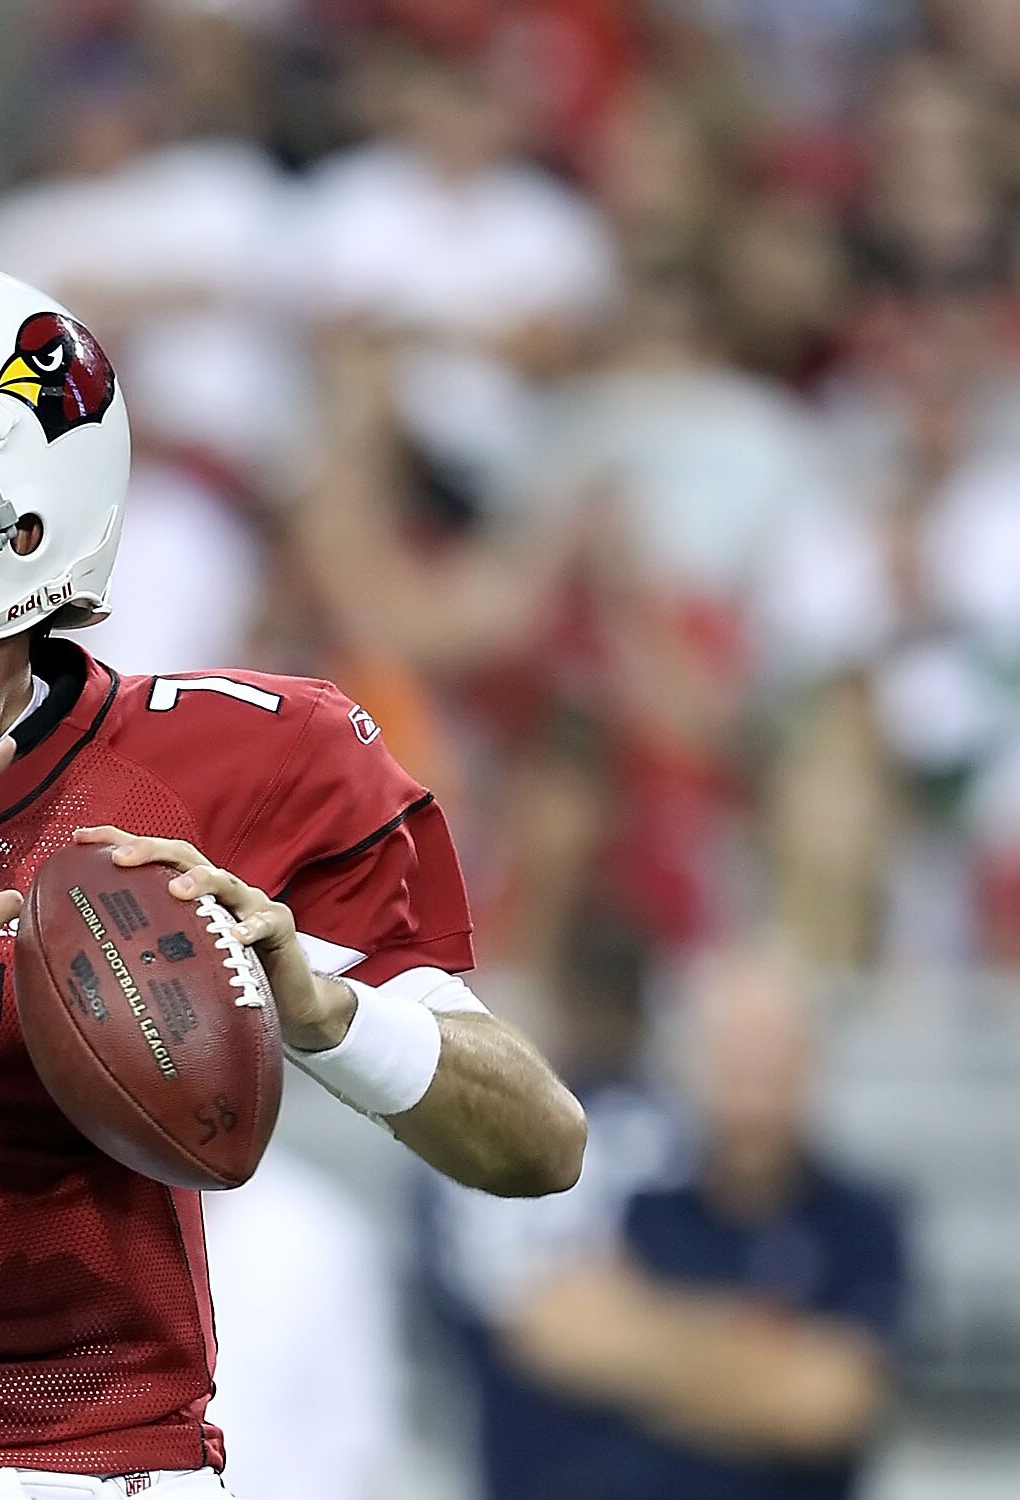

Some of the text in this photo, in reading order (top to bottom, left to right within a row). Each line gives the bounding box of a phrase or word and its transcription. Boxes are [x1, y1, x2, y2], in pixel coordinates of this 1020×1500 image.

[147, 675, 283, 713] 7
[68, 886, 106, 940] NATIONAL
[101, 941, 146, 1016] FOOTBALL
[140, 1018, 178, 1079] LEAGUE
